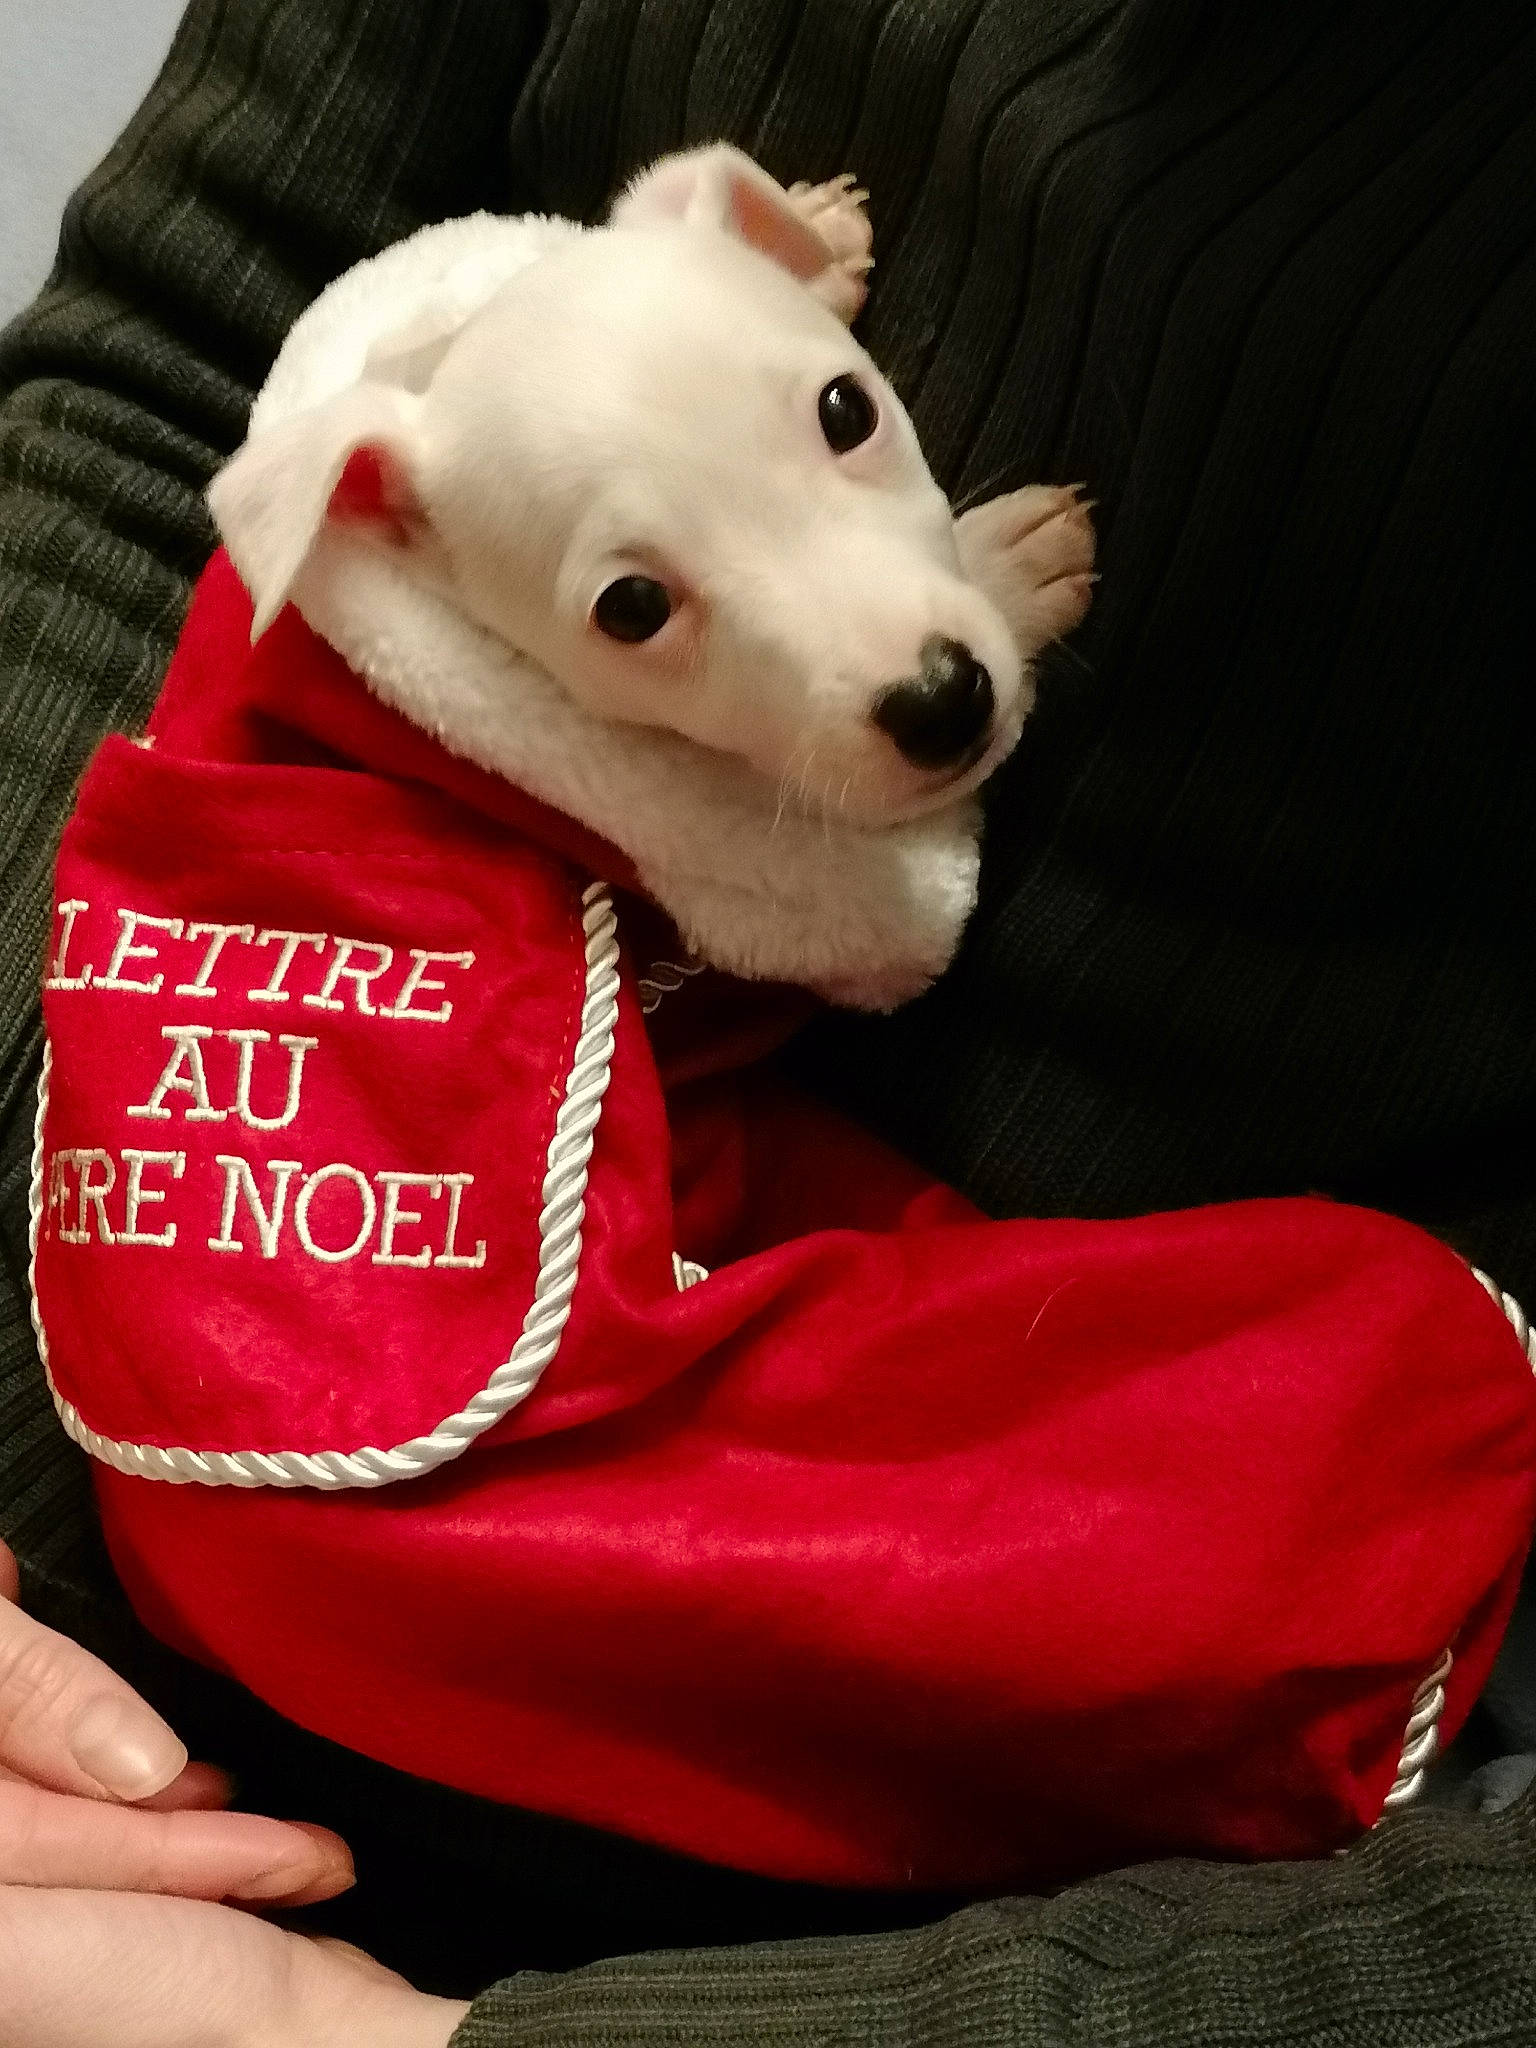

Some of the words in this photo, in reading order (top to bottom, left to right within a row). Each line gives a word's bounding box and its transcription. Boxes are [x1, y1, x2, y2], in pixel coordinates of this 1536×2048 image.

[46, 899, 475, 1022] LETTRE
[127, 1025, 319, 1131] AU
[45, 1148, 186, 1248] ERE
[208, 1154, 487, 1269] NOEL
